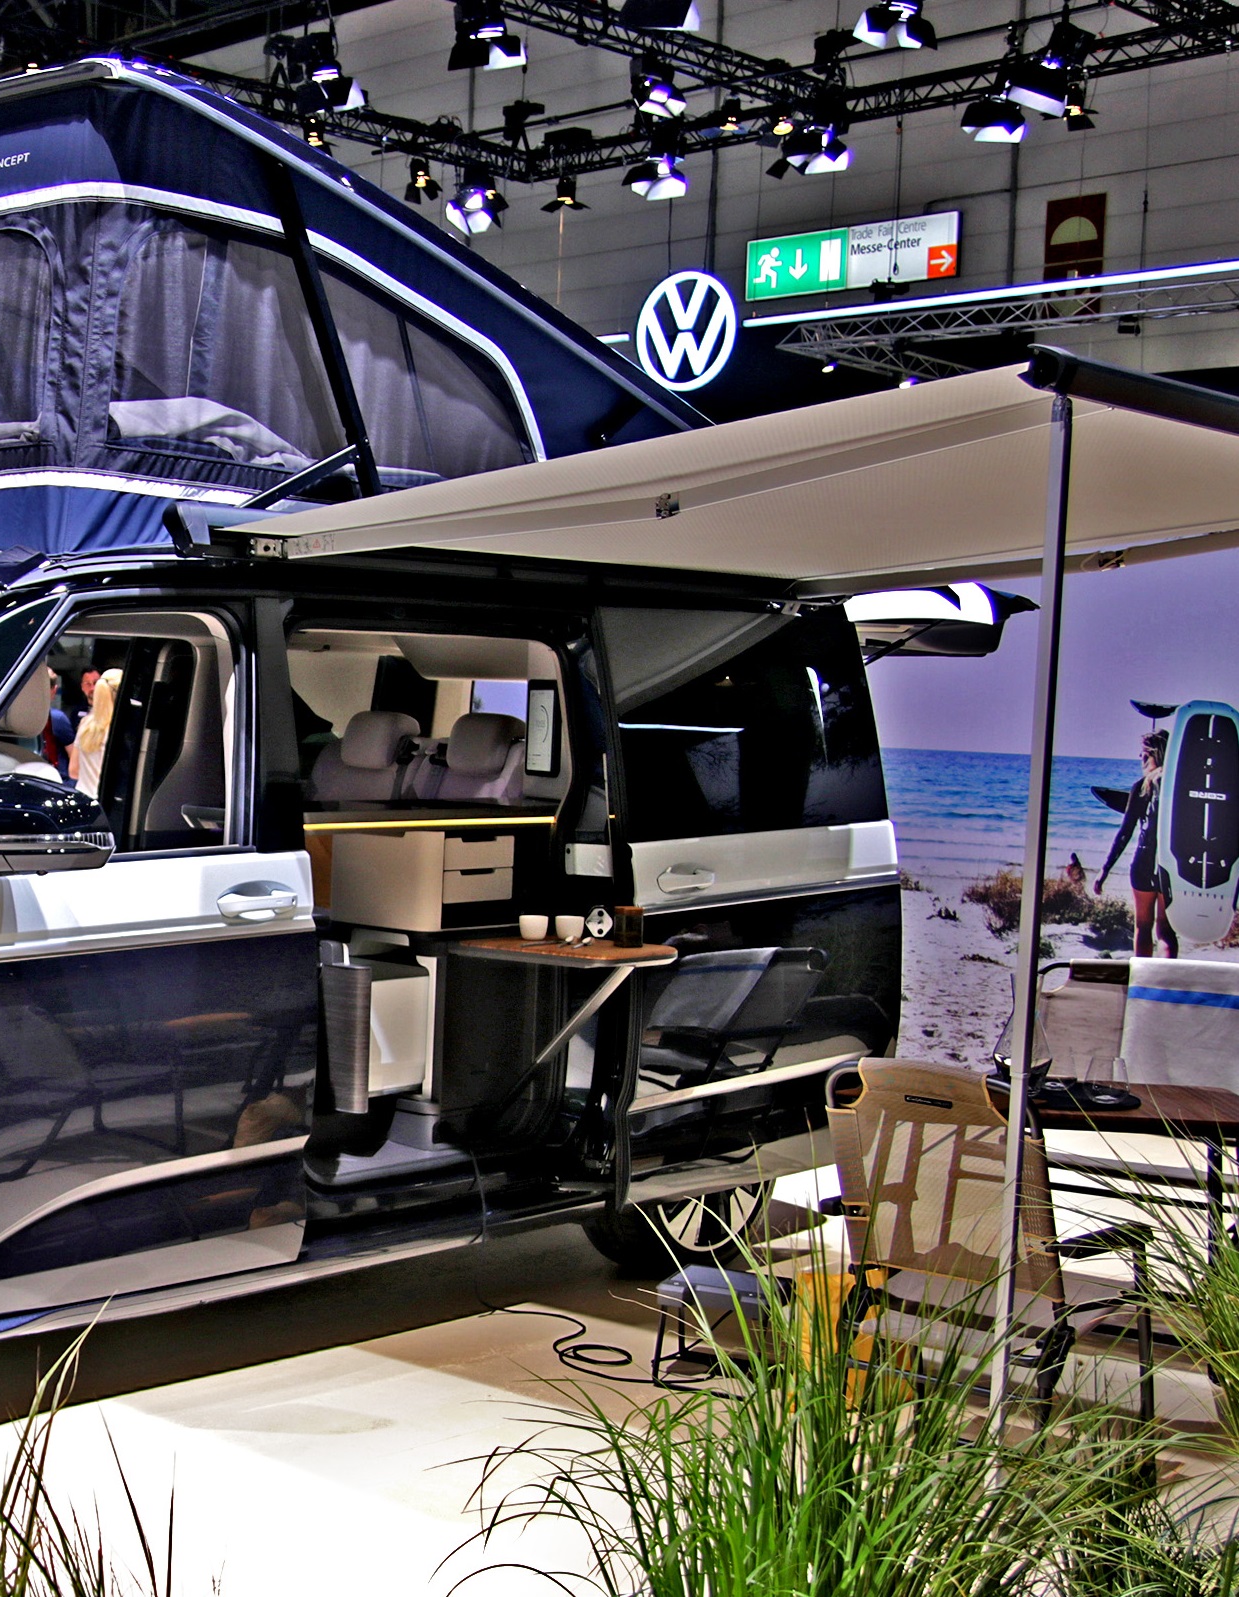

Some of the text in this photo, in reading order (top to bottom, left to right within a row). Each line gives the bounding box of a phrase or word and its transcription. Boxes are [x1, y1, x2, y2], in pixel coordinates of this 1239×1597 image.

[851, 221, 927, 241] Trade Fair Centre
[851, 237, 921, 256] Messe-Center
